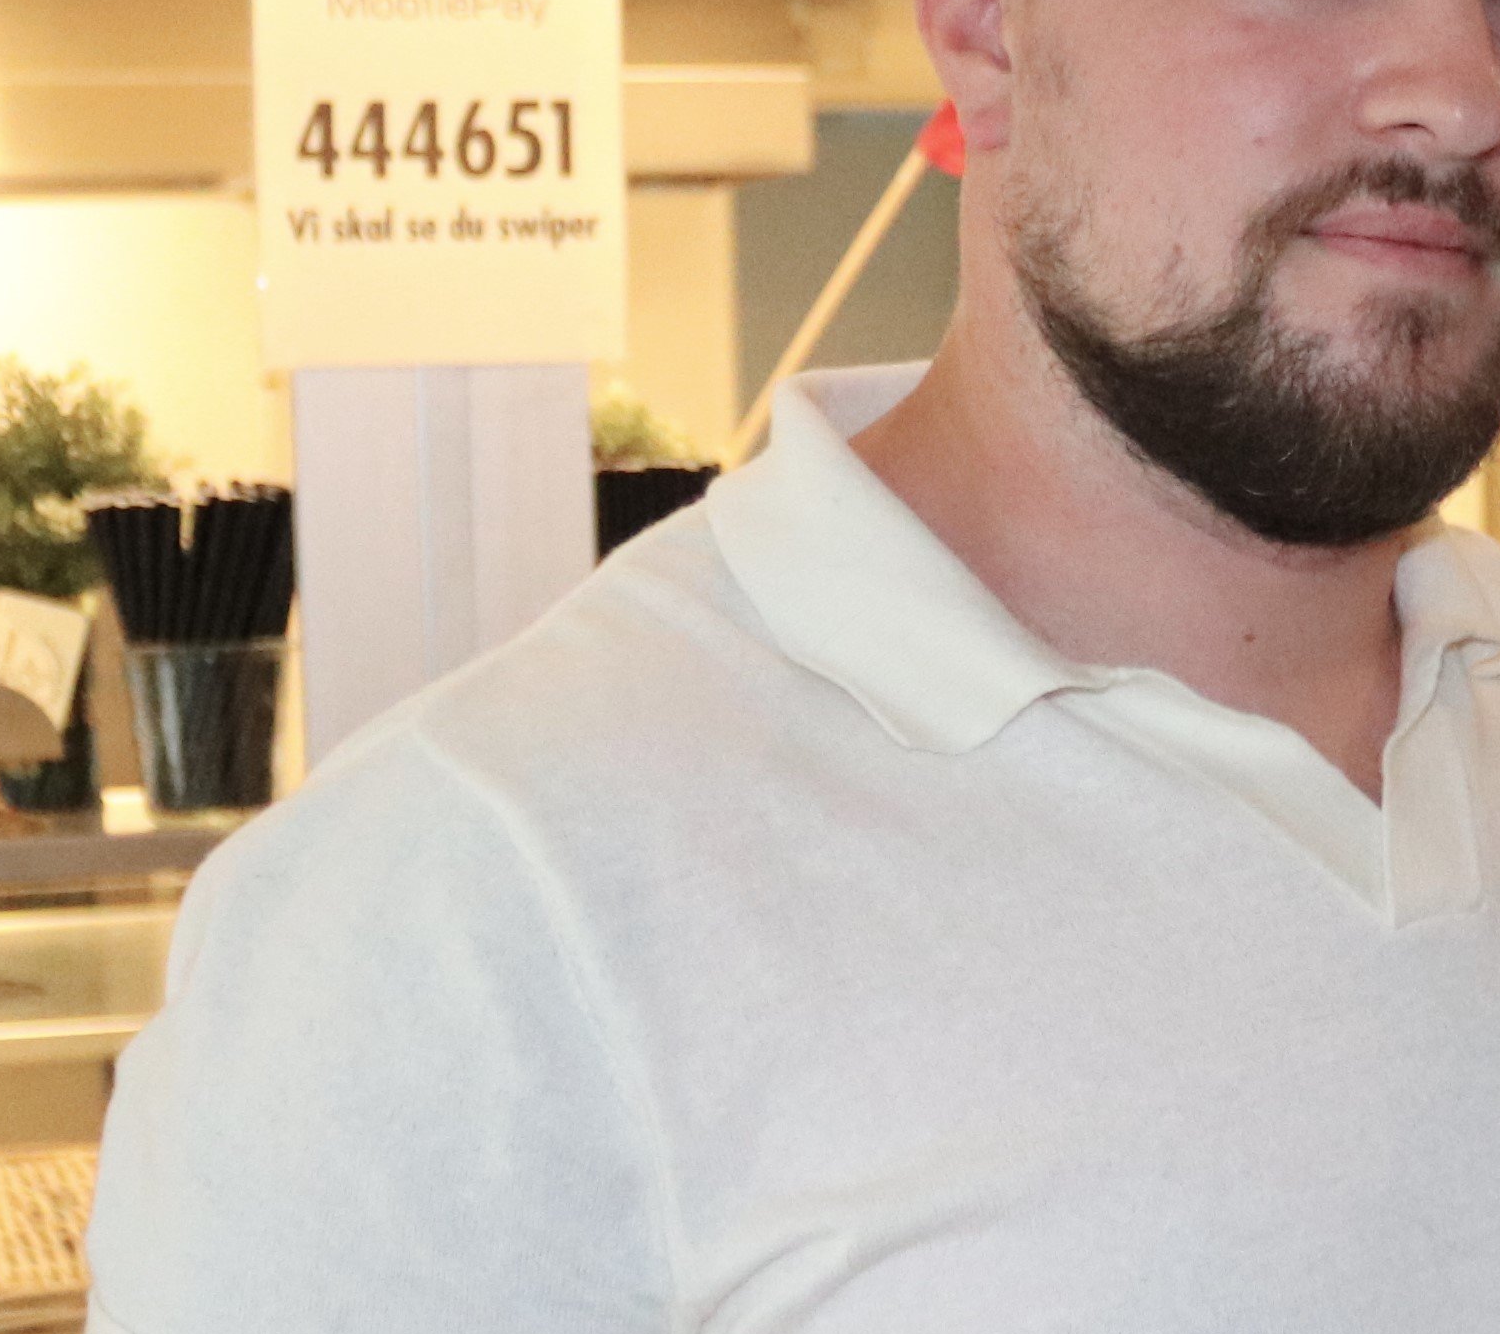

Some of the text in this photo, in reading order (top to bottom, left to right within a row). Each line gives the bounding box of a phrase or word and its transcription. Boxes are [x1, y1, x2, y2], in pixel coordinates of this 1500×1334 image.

[297, 98, 572, 179] 444651
[287, 202, 599, 250] Vi skal se du swiper
